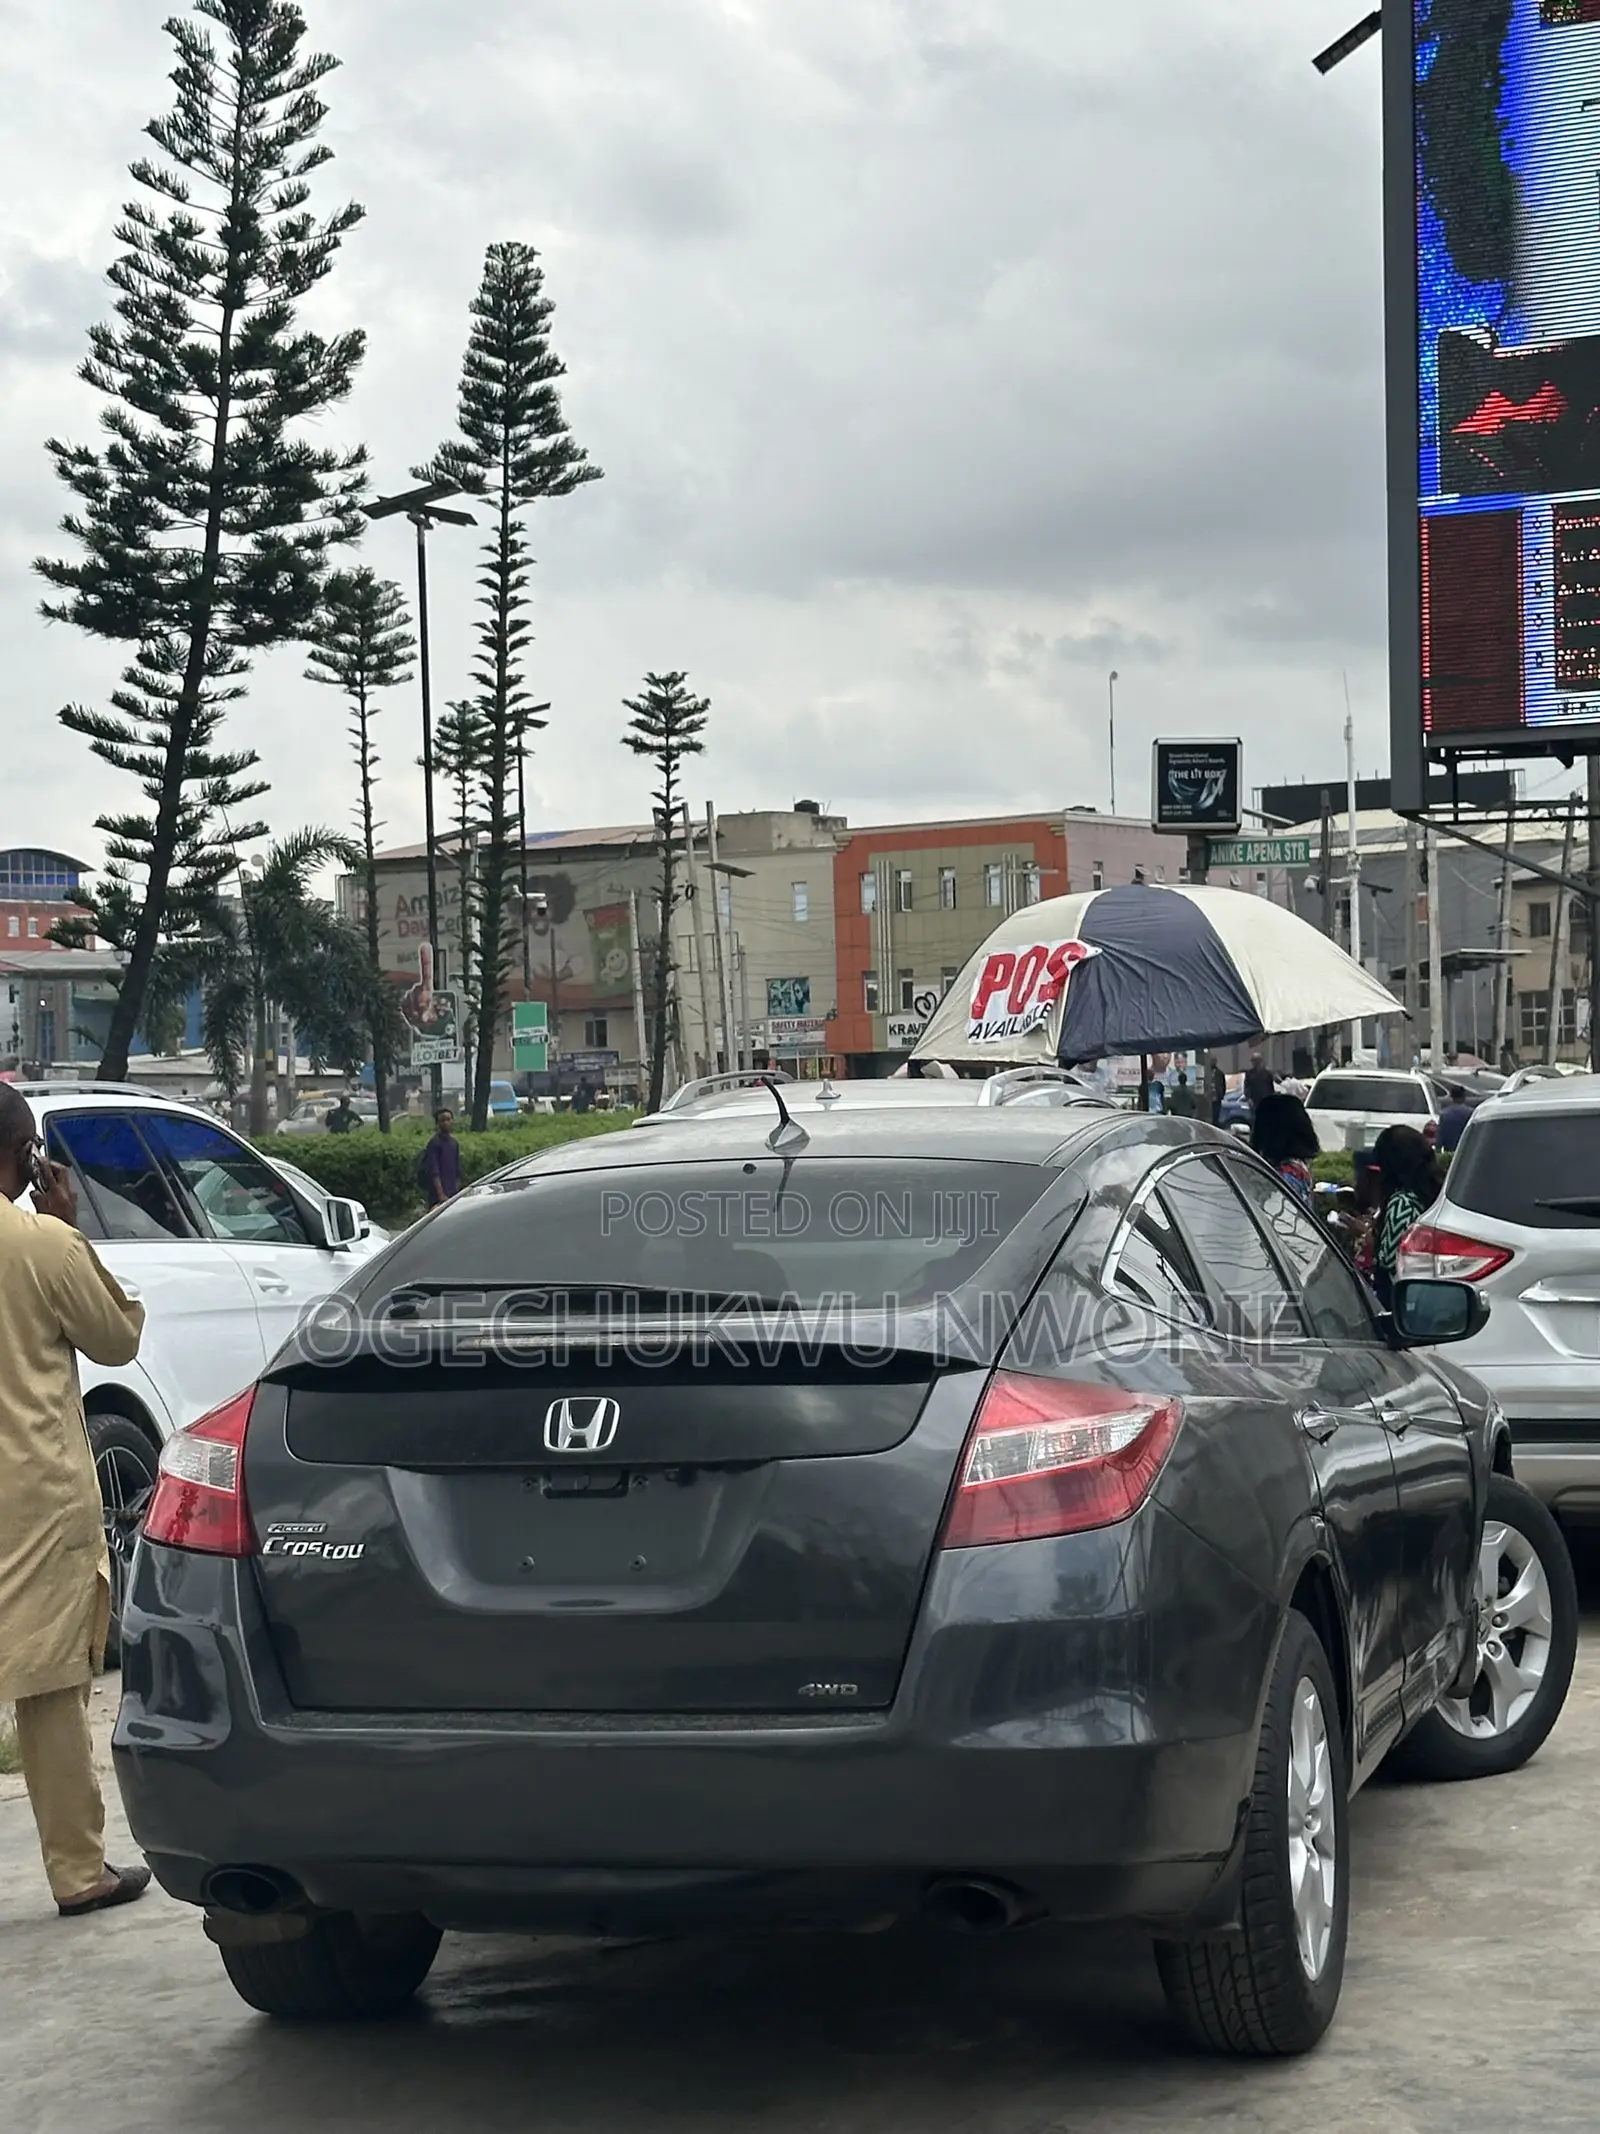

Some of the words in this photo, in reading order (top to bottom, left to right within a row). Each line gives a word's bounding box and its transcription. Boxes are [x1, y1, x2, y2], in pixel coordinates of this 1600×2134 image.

[1210, 844, 1244, 863] ANIKE
[1246, 842, 1282, 862] APENA
[1284, 841, 1306, 861] STR
[971, 942, 1088, 1020] POS
[267, 1522, 327, 1534] Accord
[797, 1683, 858, 1697] 4WD
